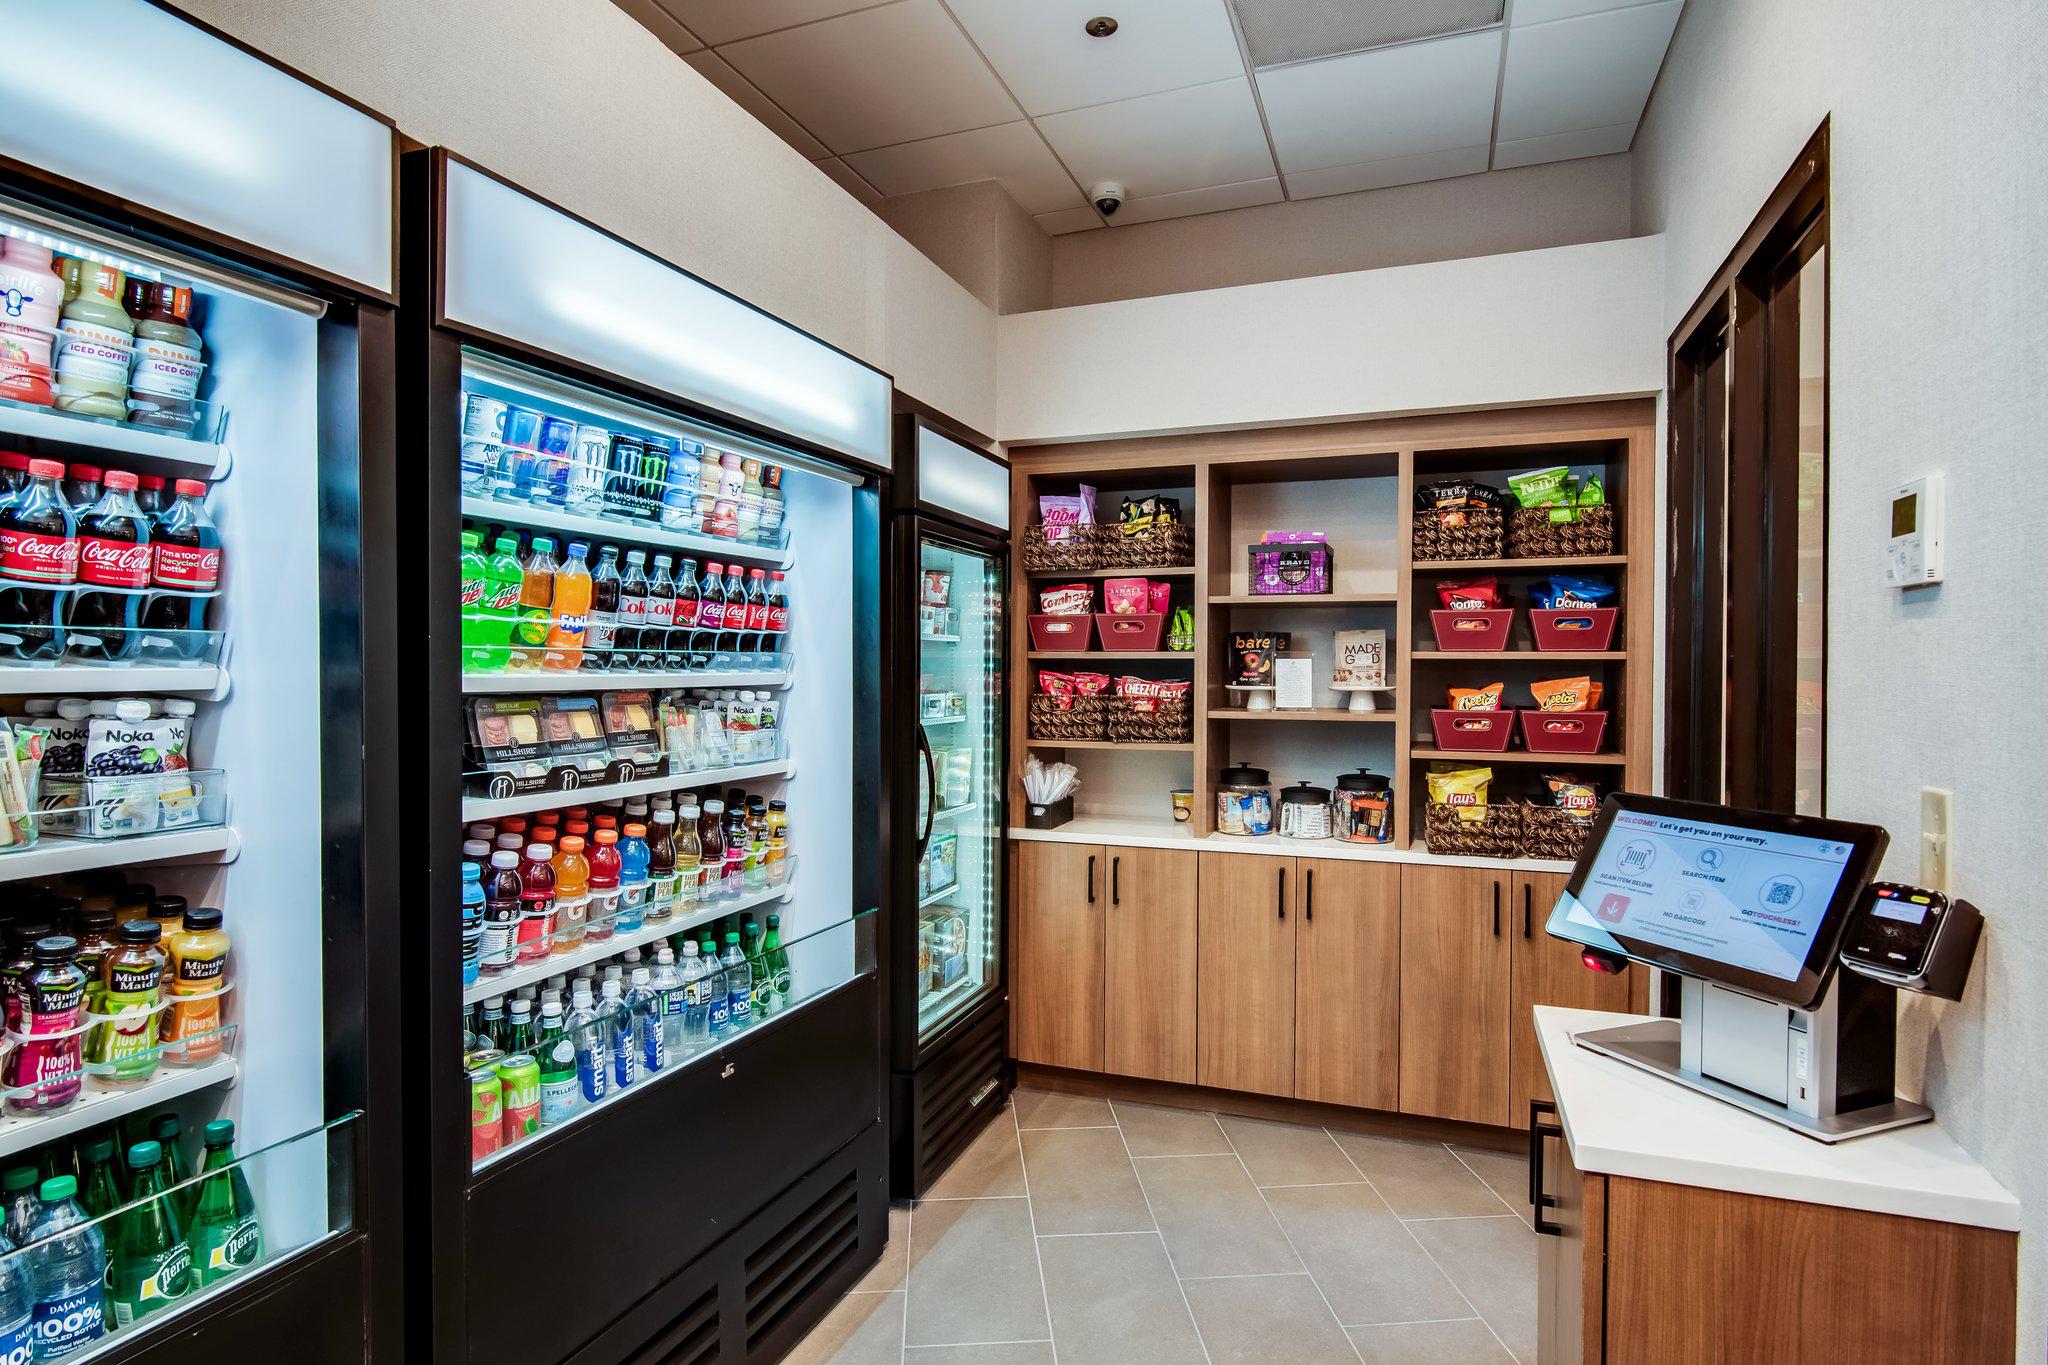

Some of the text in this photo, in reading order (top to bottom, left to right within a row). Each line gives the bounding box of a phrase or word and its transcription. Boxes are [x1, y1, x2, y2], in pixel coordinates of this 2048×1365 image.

[70, 343, 95, 355] ICED
[154, 363, 177, 373] ICED
[1434, 485, 1468, 498] TERRA
[1474, 489, 1492, 500] ERRA
[162, 557, 199, 567] Recycled
[1555, 597, 1597, 610] Doritos
[1235, 636, 1271, 649] bare
[1345, 642, 1381, 655] MADE
[733, 706, 755, 715] Noka
[106, 729, 155, 743] Noka
[617, 733, 648, 742] HILLSHIRE
[495, 747, 536, 757] HILLSHIRE
[561, 741, 597, 751] HILLSHIRE
[580, 771, 605, 780] HILLSHIRE
[516, 778, 546, 787] HILLSHIRE
[1617, 815, 1658, 828] WELCOME!
[1660, 821, 1679, 831] Let's
[1678, 824, 1693, 835] get
[1692, 827, 1710, 836] you
[1722, 831, 1745, 842] your
[1745, 836, 1769, 847] way.
[1600, 872, 1617, 882] SCAN
[1617, 876, 1632, 886] ITEM
[1632, 879, 1654, 889] BELOW
[1682, 869, 1726, 884] SEARCH ITEM
[1674, 913, 1707, 926] BARCODE
[1741, 908, 1801, 927] GOTOUCHLESS!
[185, 958, 224, 971] Minute
[115, 971, 160, 983] Minute
[189, 967, 219, 978] Maid
[120, 980, 153, 991] Maid
[47, 999, 79, 1012] Maid
[188, 1016, 216, 1031] 100%
[116, 1034, 147, 1047] 100%
[653, 1020, 664, 1067] smart
[45, 1053, 70, 1070] 100%
[624, 1033, 634, 1083] smart
[592, 1043, 605, 1097] smart
[50, 1296, 86, 1315] DASANI
[33, 1301, 102, 1339] 100%
[48, 1342, 72, 1353] Purified
